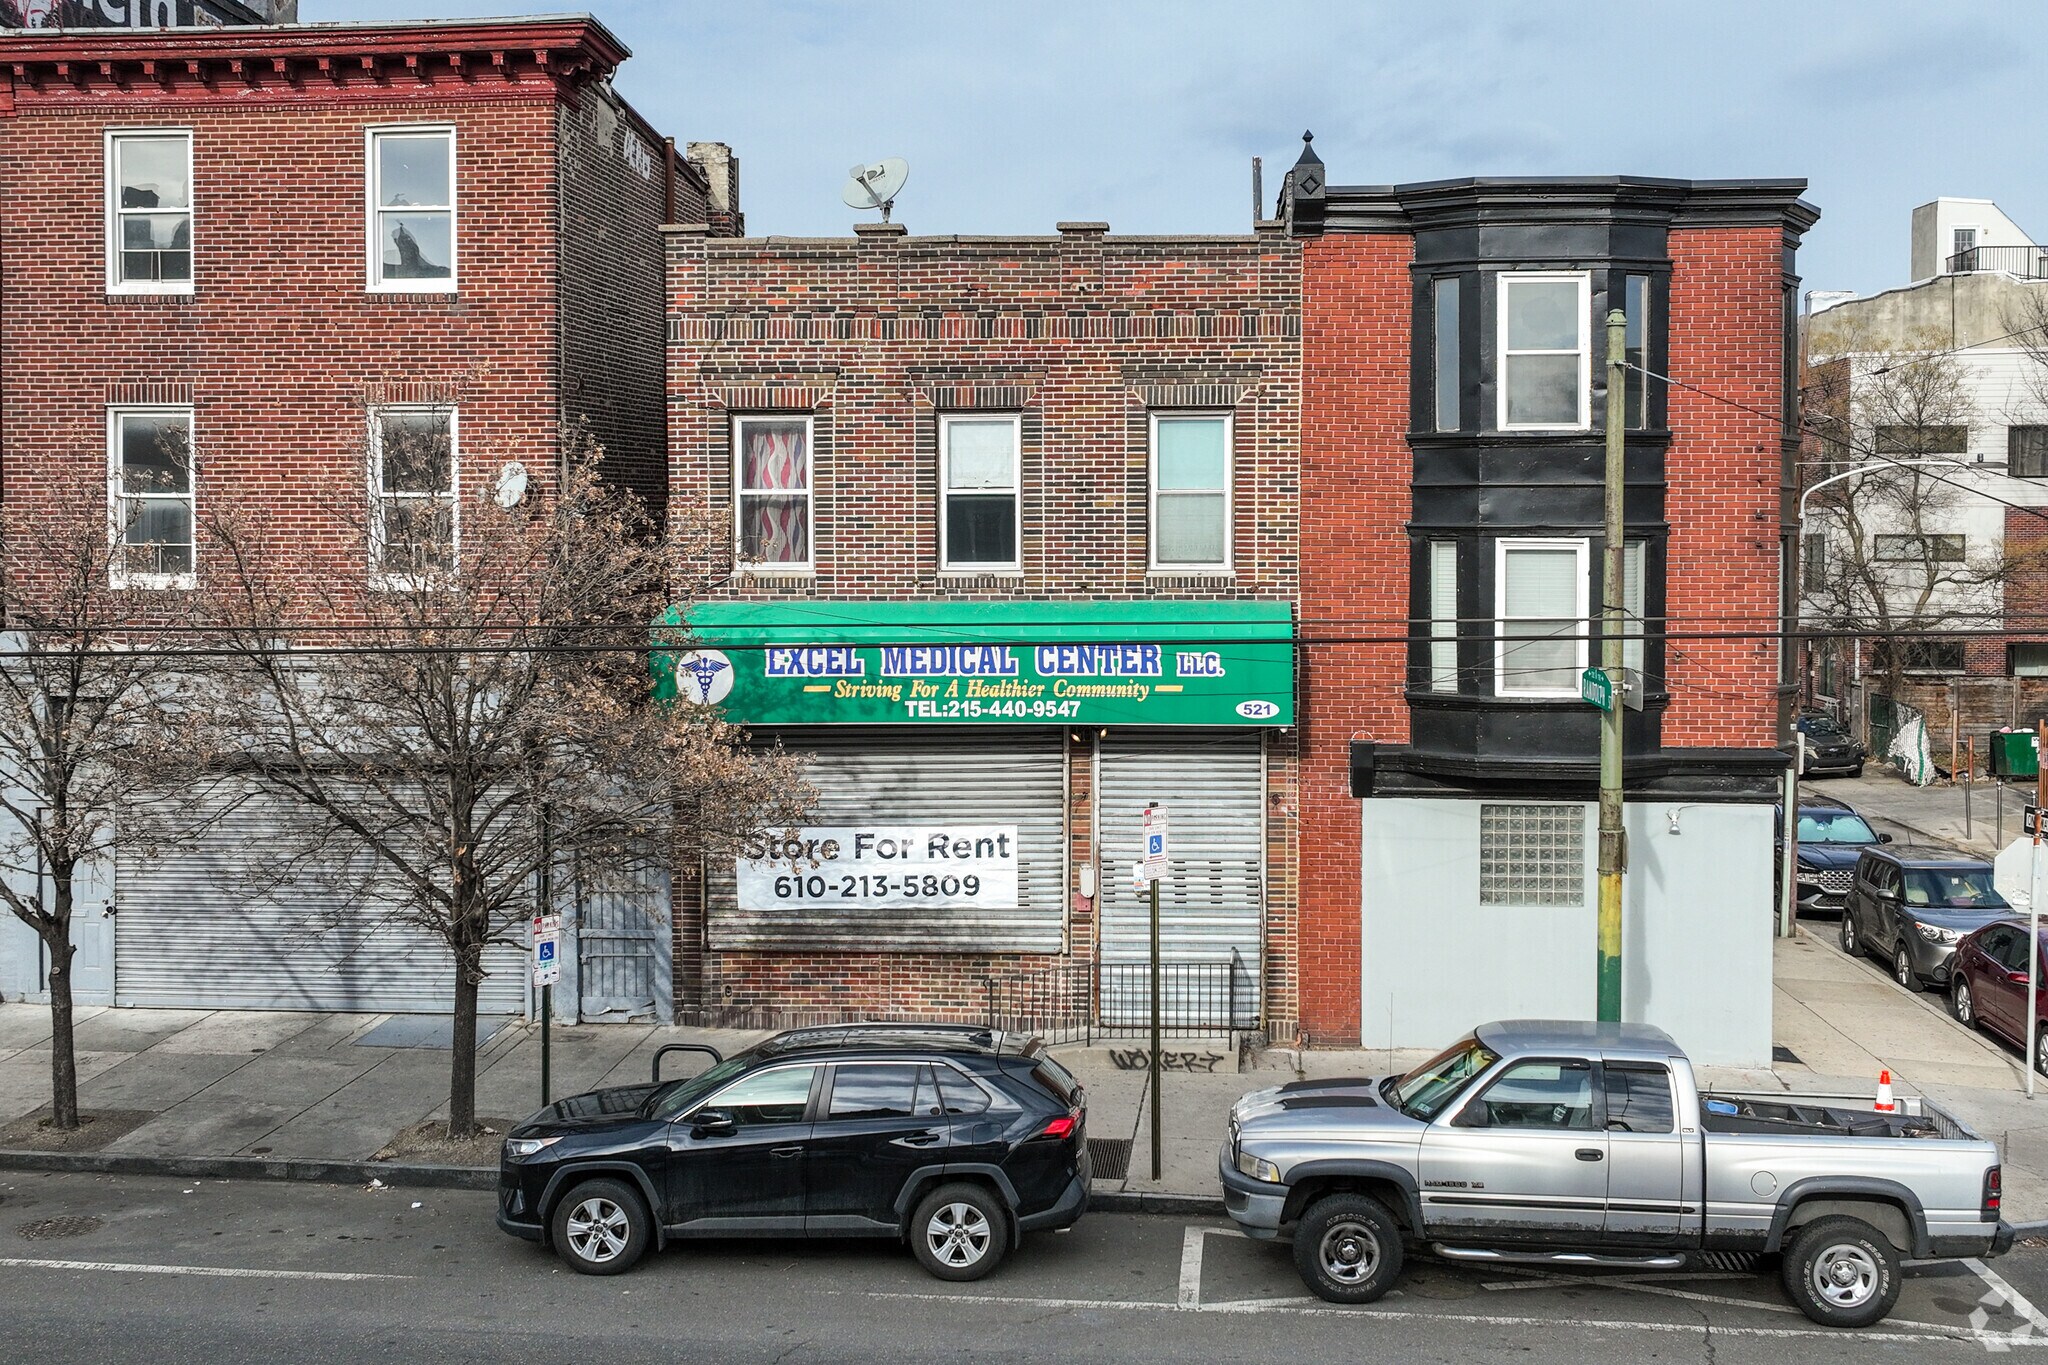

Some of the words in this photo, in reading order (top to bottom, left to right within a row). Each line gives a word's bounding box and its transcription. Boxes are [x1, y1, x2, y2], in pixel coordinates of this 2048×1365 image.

[765, 643, 865, 677] EXCEL
[881, 642, 1019, 676] MEDICAL
[1035, 640, 1162, 676] CENTER
[834, 680, 902, 702] Striving
[910, 680, 939, 698] For
[944, 680, 958, 698] A
[967, 679, 1045, 698] Healthier
[1053, 679, 1150, 702] Community
[1583, 677, 1606, 707] RANDOLPH
[905, 701, 1081, 718] TEL:215-440-9547
[1243, 704, 1272, 716] 521
[748, 834, 841, 861] Store
[855, 833, 914, 860] For
[928, 833, 1010, 859] Rent
[774, 874, 981, 898] 610-213-5809
